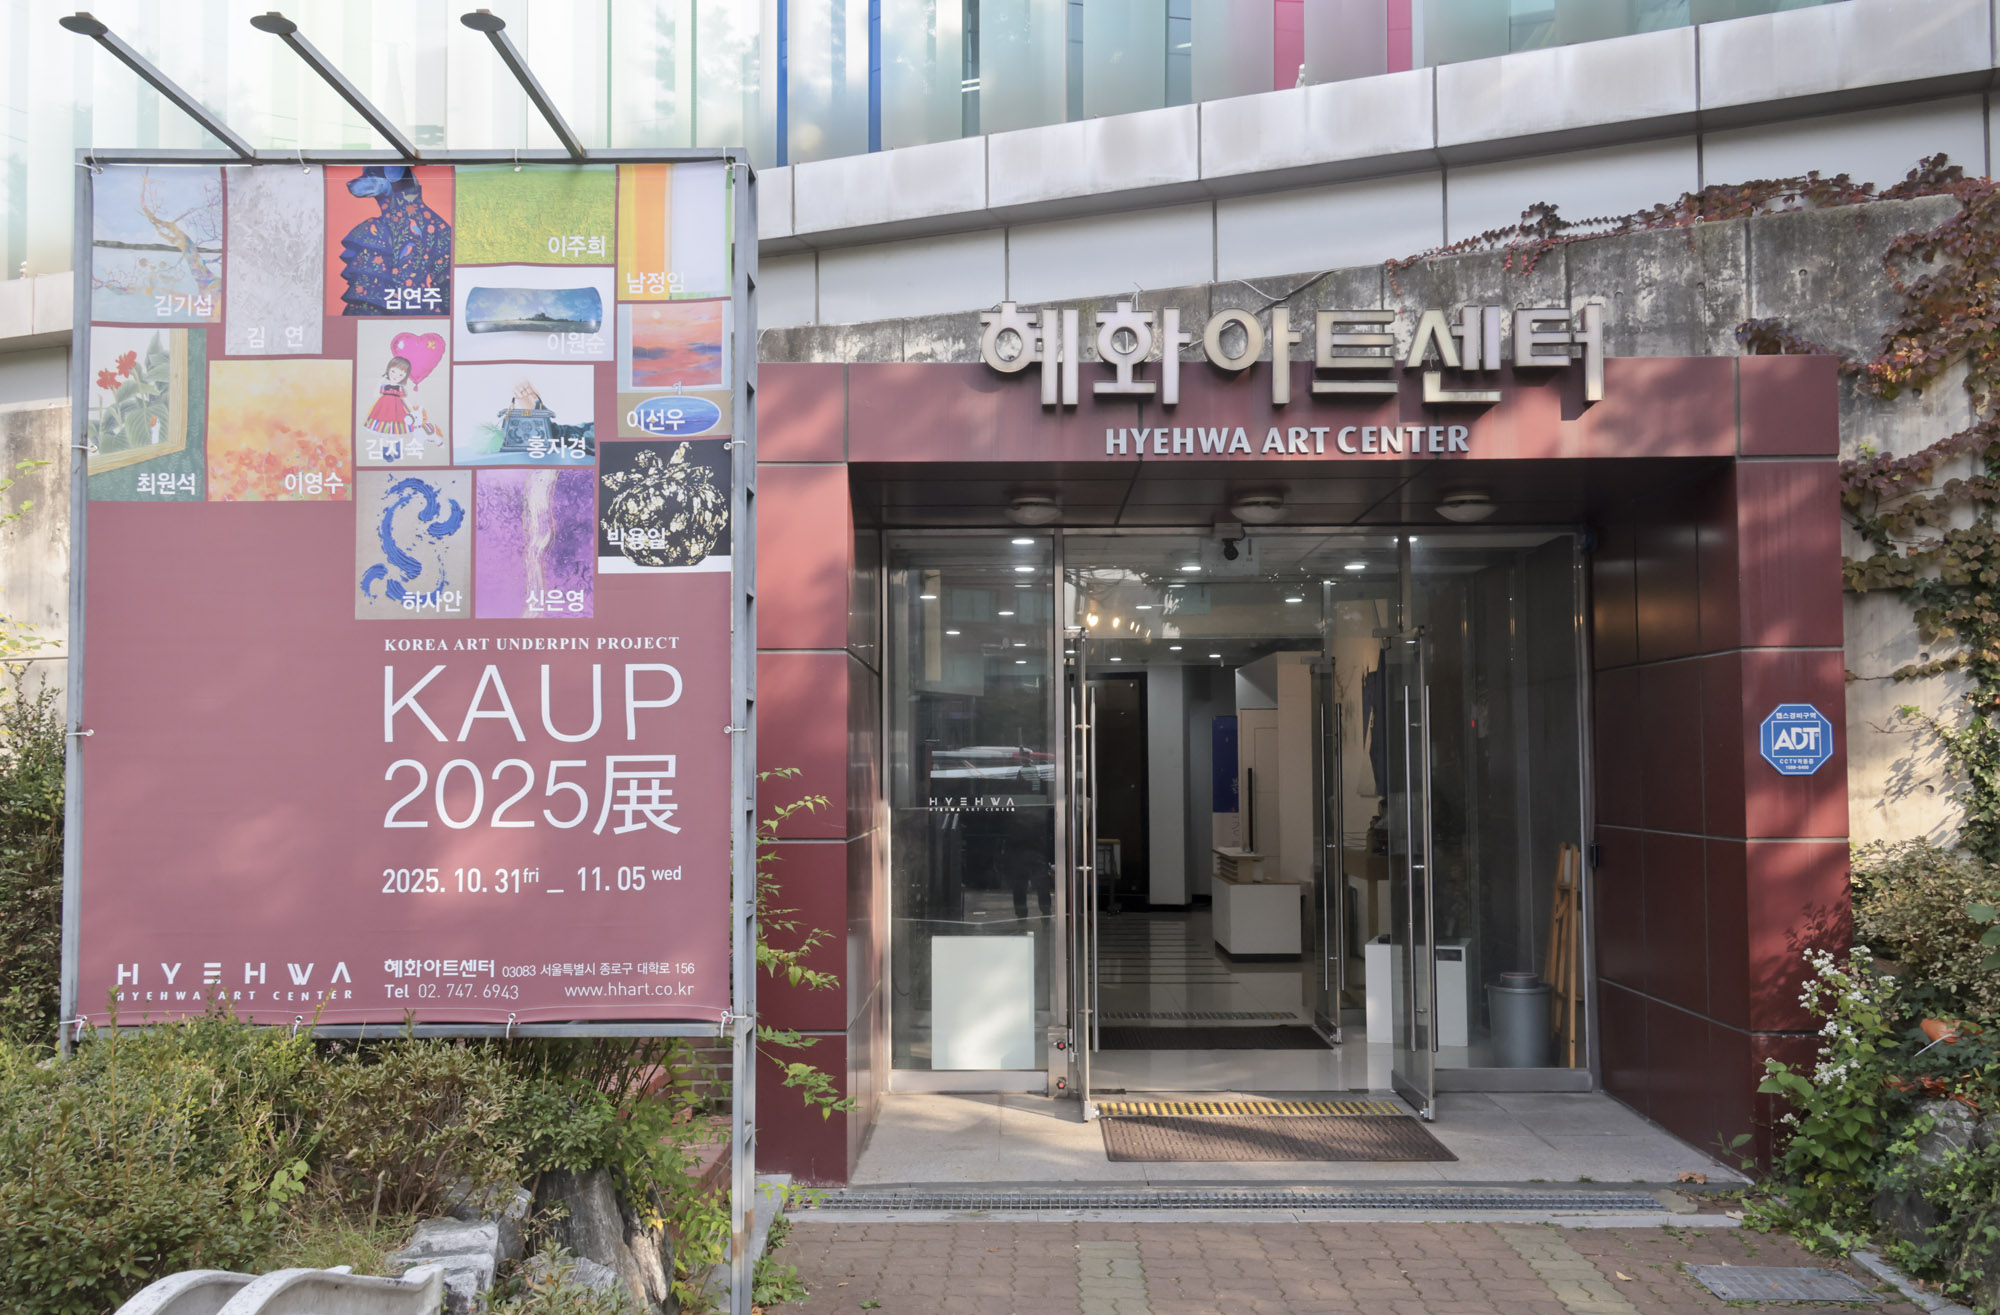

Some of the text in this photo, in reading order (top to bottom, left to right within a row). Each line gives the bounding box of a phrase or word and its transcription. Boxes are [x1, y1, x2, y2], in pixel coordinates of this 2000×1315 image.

[548, 236, 606, 258] 이주희
[627, 271, 684, 294] 남정임
[154, 294, 213, 317] 김기섭
[384, 287, 442, 311] 김연주
[547, 332, 606, 355] 이원순
[979, 301, 1604, 407] 혜화아트센터
[627, 409, 685, 431] 이선우
[365, 437, 424, 460] 김지숙
[527, 436, 587, 459] 홍자경
[1105, 425, 1470, 456] HYEHWA ART CENTER
[136, 473, 196, 496] 최원석
[284, 472, 344, 494] 이영수
[402, 590, 462, 613] 하사안
[526, 589, 585, 612] 신은영
[384, 636, 680, 651] KOREA ART UNDERPIN PROJECT
[383, 663, 684, 743] KAUP
[1774, 727, 1820, 750] ADT
[383, 754, 682, 835] 2025展
[929, 797, 1015, 806] HYEHWA
[382, 868, 446, 894] 2025.
[454, 867, 488, 893] 10.
[577, 866, 611, 892] 11.
[117, 961, 352, 986] HYEHWA
[384, 958, 696, 978] 혜화아트센터 03083 서울특별시 종로구 대학로 156
[218, 990, 257, 1001] ART
[272, 990, 352, 1001] CENTER
[384, 981, 695, 1000] Tel 02. 747. 6943 www.hhart.co.kr
